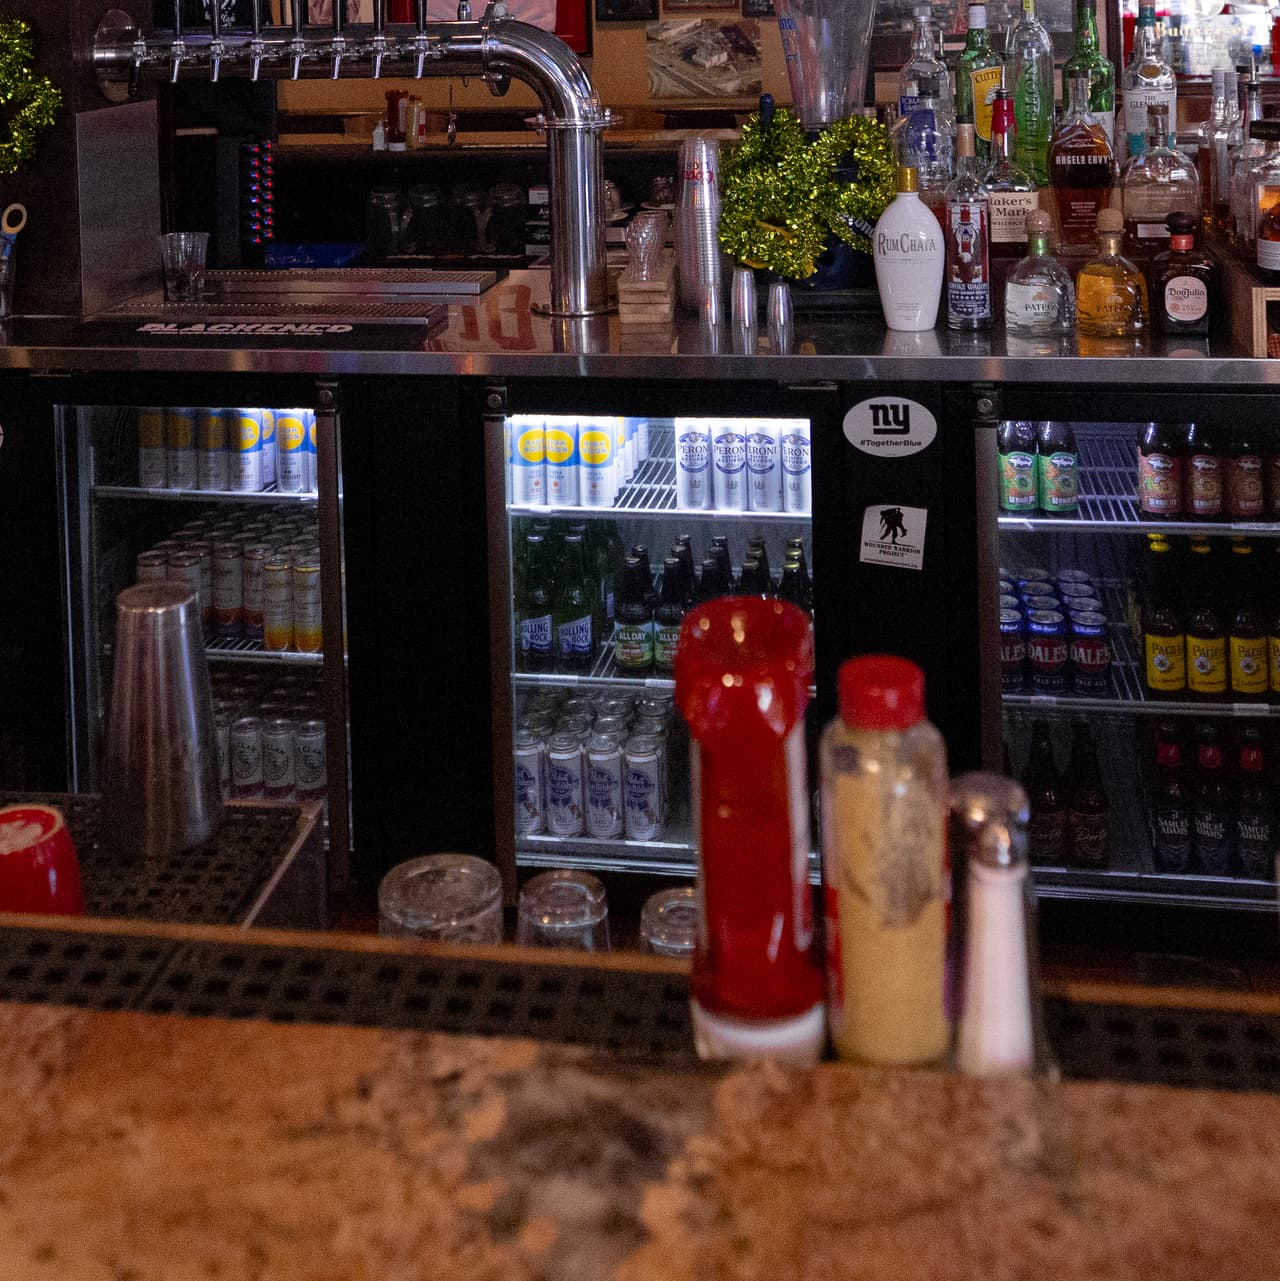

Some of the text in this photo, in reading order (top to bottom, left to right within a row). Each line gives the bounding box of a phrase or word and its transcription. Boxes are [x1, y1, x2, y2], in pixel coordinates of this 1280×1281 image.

[1087, 154, 1108, 165] ENVY
[995, 206, 1031, 217] Mark
[139, 323, 355, 336] BLACKENED
[869, 404, 911, 435] ny
[860, 439, 922, 448] #TogetherBlue
[677, 444, 709, 454] PERON
[714, 445, 745, 455] PERON
[748, 446, 777, 455] ERONI
[783, 447, 809, 457] ERON
[864, 541, 921, 555] WOUNDED WARRIOR
[879, 549, 905, 558] PROJECT
[560, 623, 590, 637] ROLLING
[529, 632, 550, 642] ROCK
[571, 634, 590, 644] ROCK
[619, 631, 647, 641] ALL DAY
[659, 632, 673, 642] ALL
